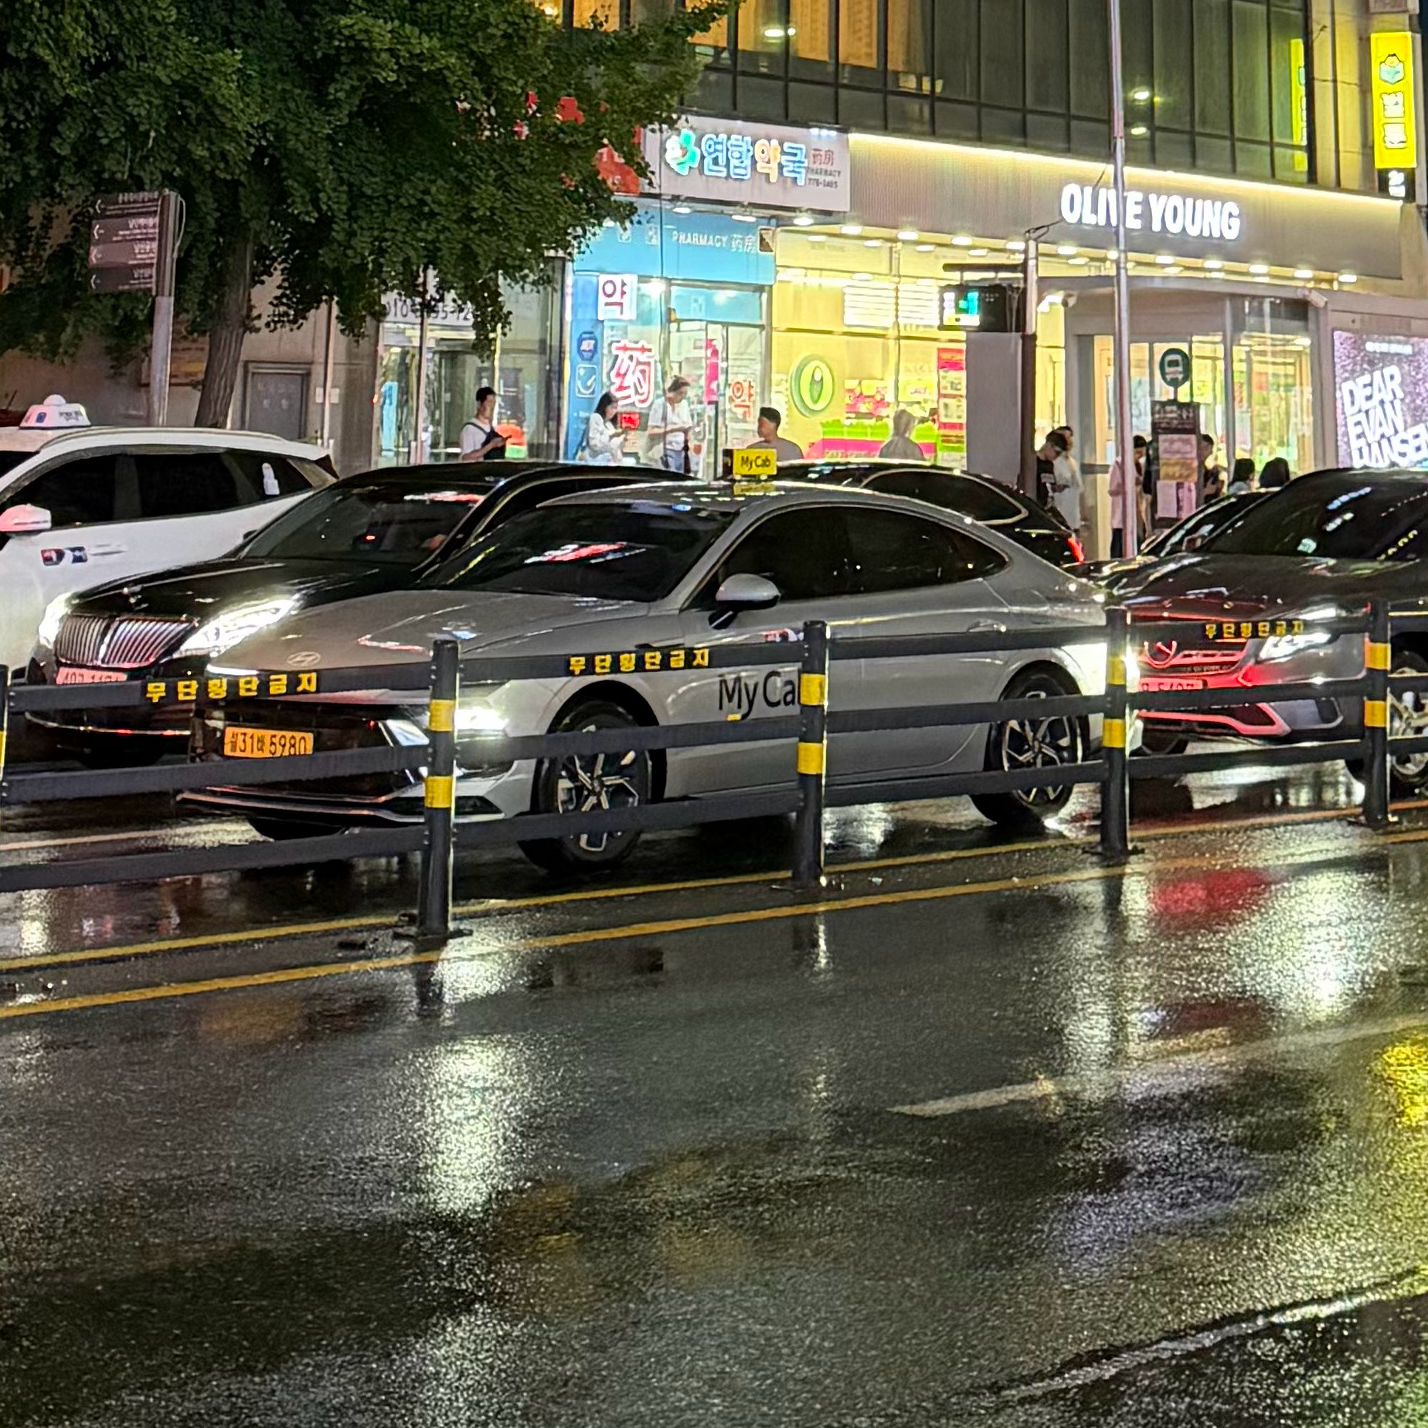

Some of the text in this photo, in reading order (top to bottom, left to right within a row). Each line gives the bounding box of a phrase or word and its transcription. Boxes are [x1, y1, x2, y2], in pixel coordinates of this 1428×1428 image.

[701, 132, 809, 187] 연합약국
[1148, 193, 1241, 240] YOUNG
[672, 230, 728, 247] PHARMACY
[602, 278, 628, 316] 약
[610, 341, 655, 407] 药
[1341, 365, 1405, 416] DEAR
[1346, 399, 1406, 448] EVAN
[741, 455, 771, 472] My Cab
[569, 648, 710, 675] 무단횡단금지
[145, 672, 319, 703] 무단횡단금지
[718, 670, 800, 721] My Ca
[269, 734, 308, 756] 5980
